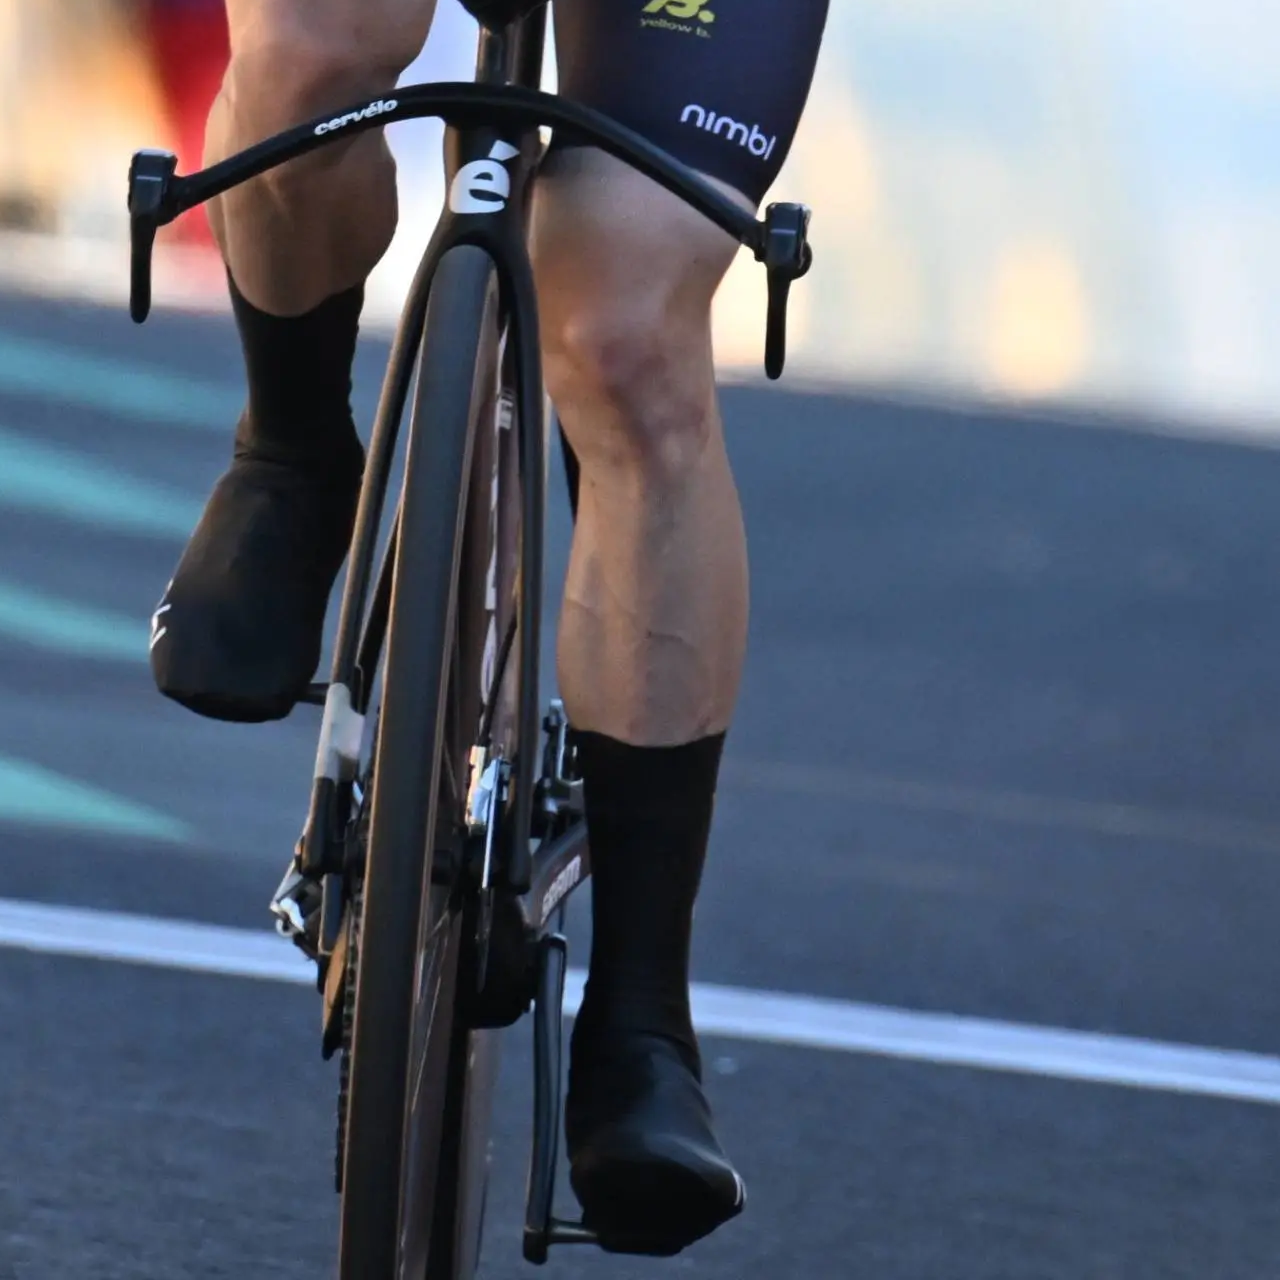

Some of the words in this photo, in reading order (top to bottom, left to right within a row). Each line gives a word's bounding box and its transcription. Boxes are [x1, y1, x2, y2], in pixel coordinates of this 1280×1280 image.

[639, 17, 693, 34] yellow
[314, 98, 399, 136] cervélo
[679, 103, 777, 161] nimbl
